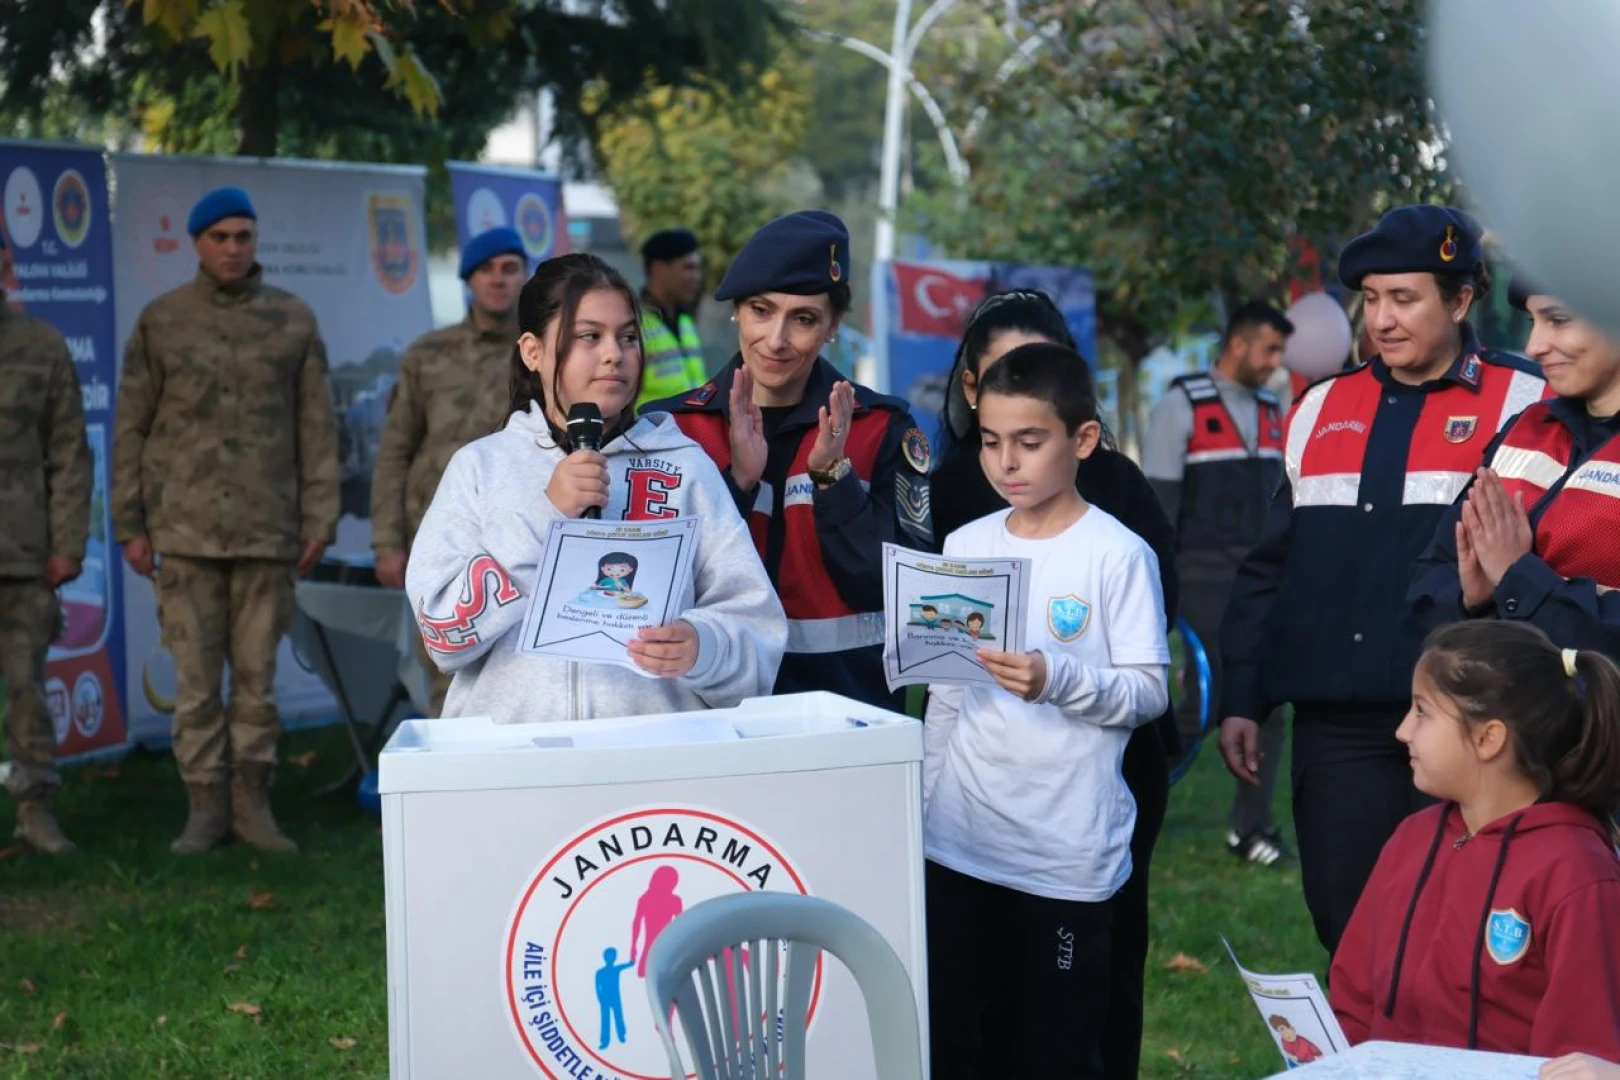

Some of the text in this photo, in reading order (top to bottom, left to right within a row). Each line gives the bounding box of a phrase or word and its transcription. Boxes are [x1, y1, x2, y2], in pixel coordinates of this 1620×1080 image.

[628, 457, 681, 475] VARSITY
[622, 467, 682, 521] E
[562, 605, 598, 618] Dengeli
[553, 823, 774, 900] JANDARMA
[1056, 926, 1074, 970] STB
[520, 941, 594, 1080] AİLE İÇİ ŞİDDETLE
